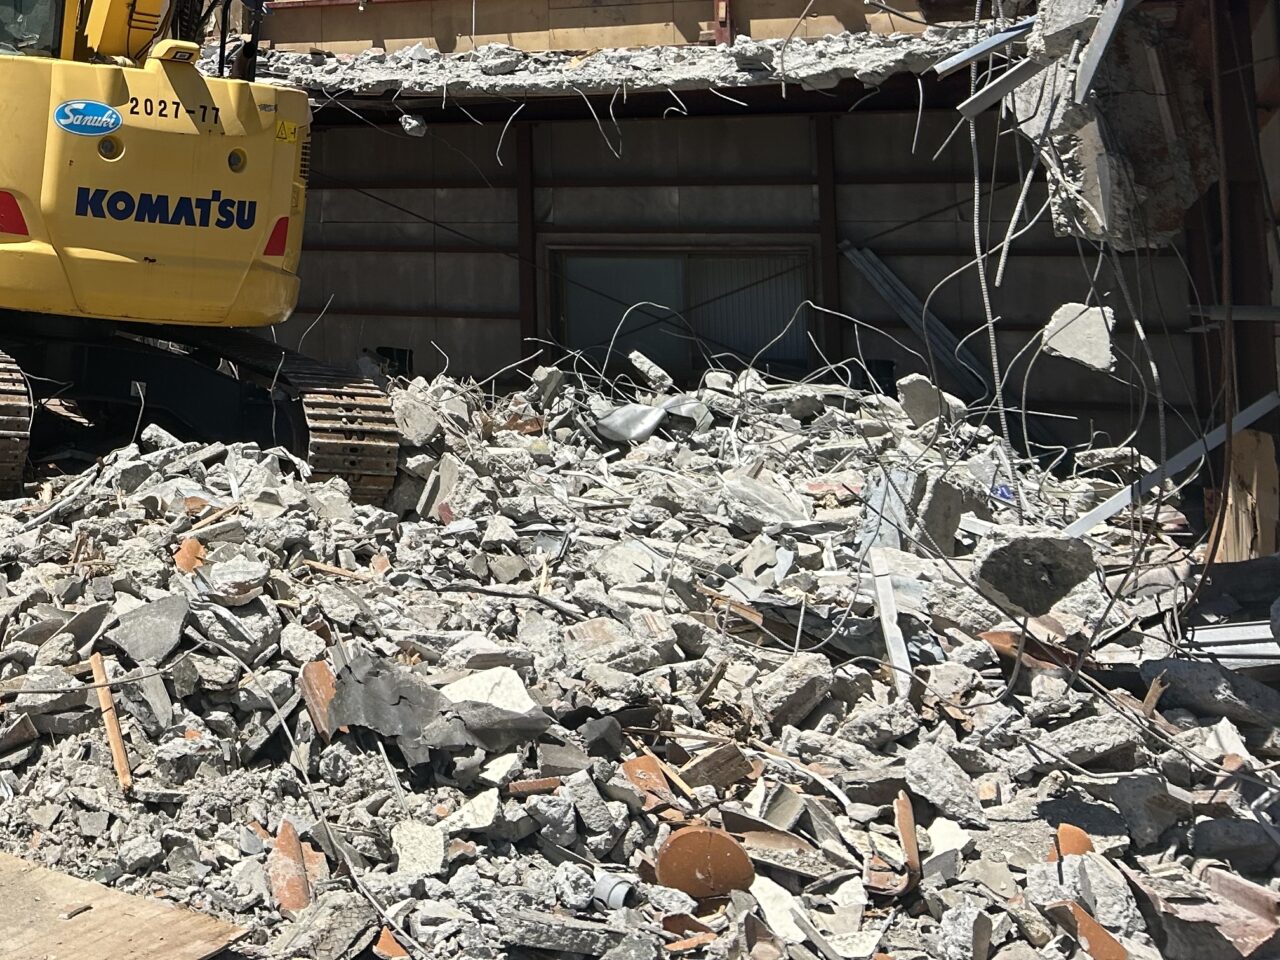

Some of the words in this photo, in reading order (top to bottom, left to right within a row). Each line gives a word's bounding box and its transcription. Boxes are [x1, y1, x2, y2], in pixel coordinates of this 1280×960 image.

[59, 103, 117, 128] Sanuki
[129, 97, 220, 124] 2027-77
[75, 186, 257, 230] KOMATSU
